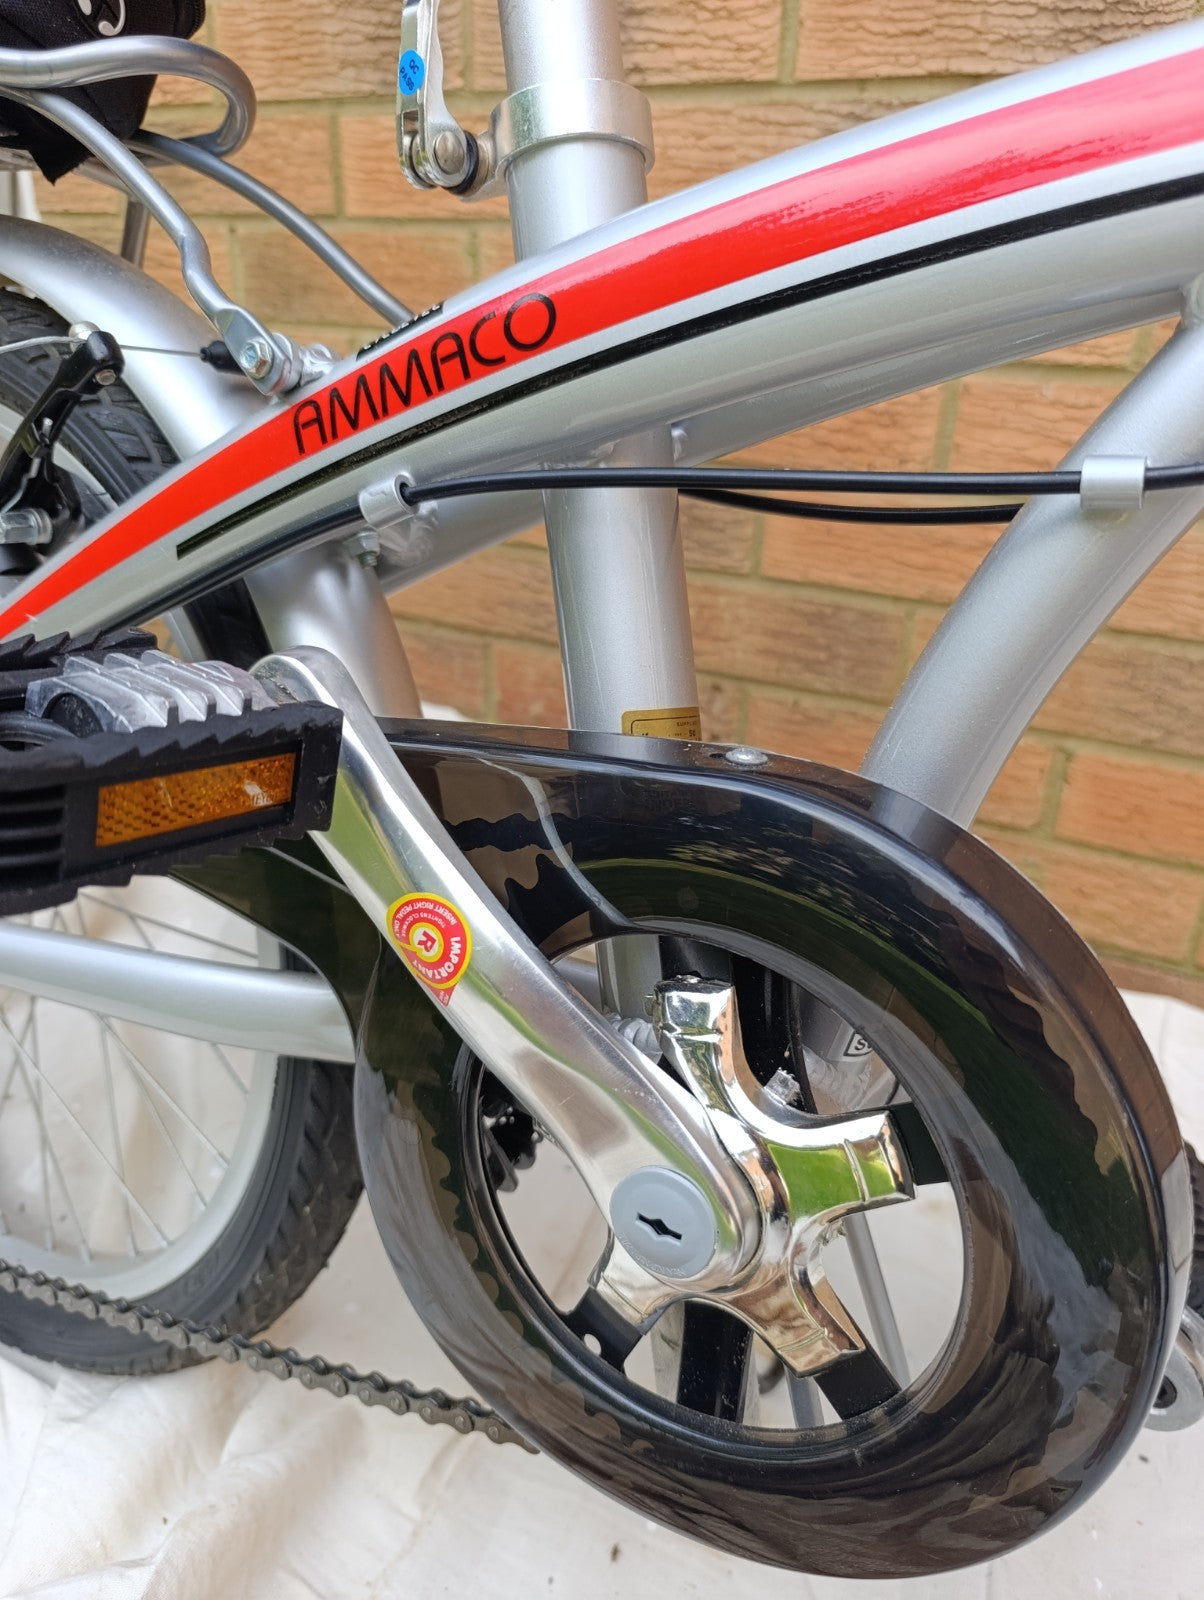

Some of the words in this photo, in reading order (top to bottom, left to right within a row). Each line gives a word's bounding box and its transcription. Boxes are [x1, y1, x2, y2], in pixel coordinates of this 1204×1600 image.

[409, 59, 419, 74] QC
[400, 67, 415, 91] PASS
[293, 292, 557, 455] AMMACO
[396, 904, 413, 919] PEDAL
[413, 901, 434, 910] RIGHT
[434, 905, 457, 925] INSERT
[420, 913, 446, 929] TIGHTENS
[417, 930, 437, 952] R
[412, 936, 462, 979] IMPORTANT
